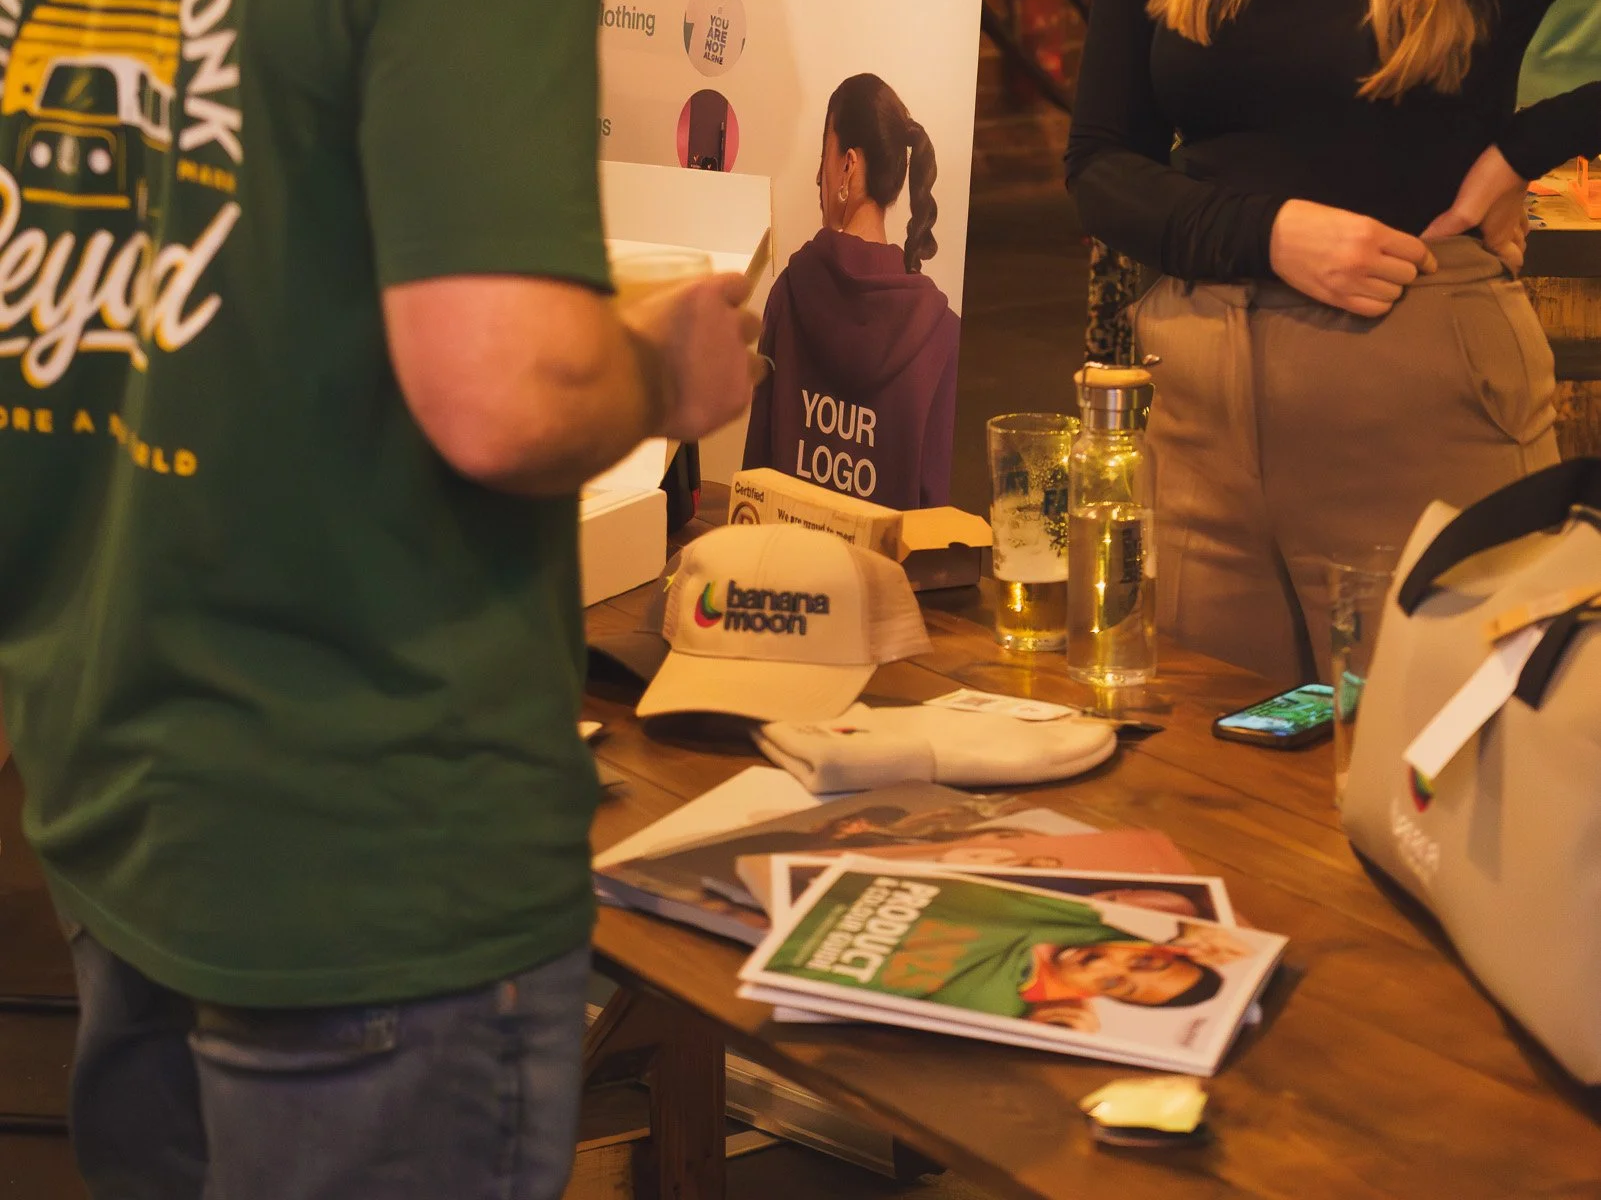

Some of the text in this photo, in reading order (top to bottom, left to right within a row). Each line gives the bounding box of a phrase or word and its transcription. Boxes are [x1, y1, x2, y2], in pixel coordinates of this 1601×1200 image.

[710, 15, 730, 30] YOU
[707, 26, 728, 44] ARE
[704, 39, 726, 56] NOT
[802, 389, 877, 448] YOUR
[796, 439, 877, 497] LOGO
[734, 480, 765, 503] Certified
[726, 579, 829, 615] banana
[724, 610, 807, 636] moon
